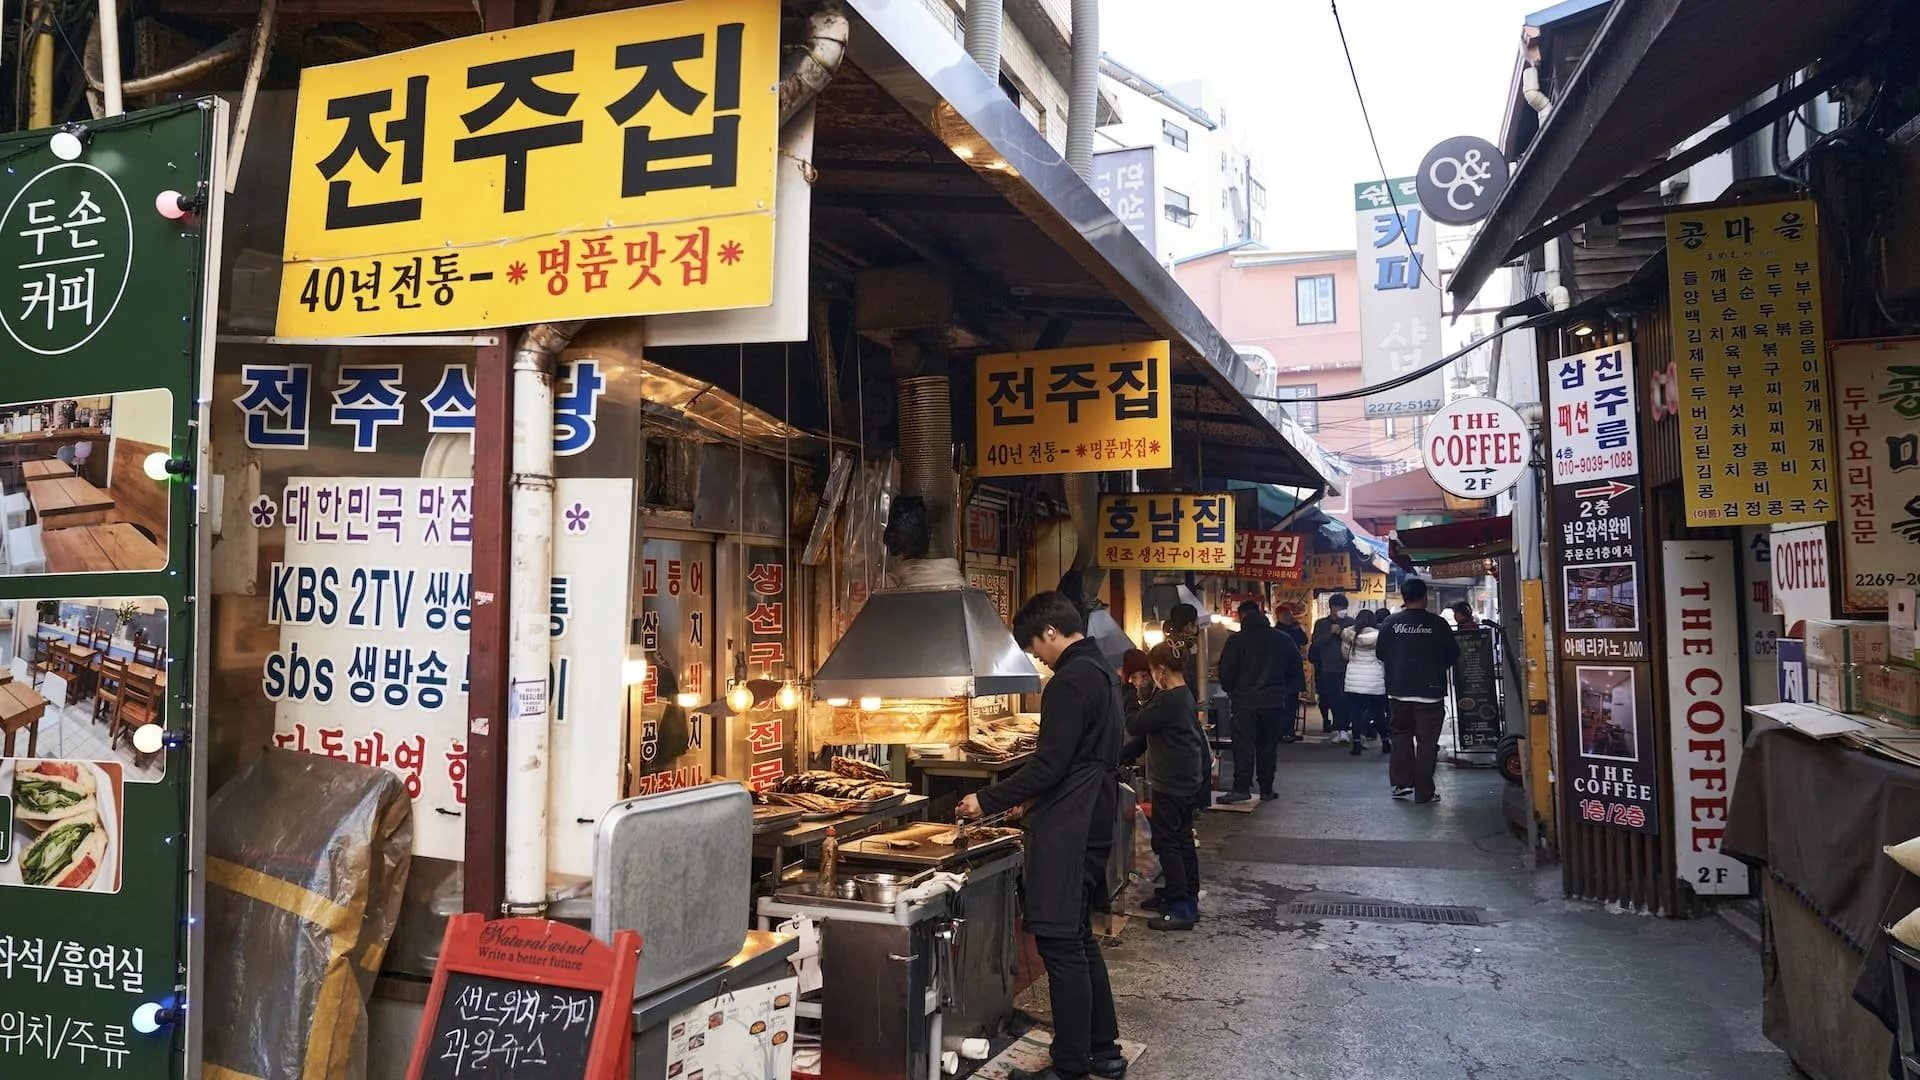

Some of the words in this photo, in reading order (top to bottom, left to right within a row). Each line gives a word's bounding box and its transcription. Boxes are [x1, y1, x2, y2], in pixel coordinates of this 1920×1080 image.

[316, 23, 745, 231] 전주집
[19, 190, 107, 255] 두손
[20, 268, 96, 331] 커피
[987, 358, 1159, 426] 전주집
[1368, 399, 1441, 414] 2272-5147
[1449, 413, 1501, 429] THE
[1558, 400, 1589, 437] 패션
[1431, 431, 1522, 467] COFFEE
[1556, 446, 1574, 460] 4층
[1558, 450, 1633, 477] 010-9039-1088
[1843, 387, 1878, 545] 두부요리전문
[285, 485, 403, 544] 대한민국
[419, 485, 473, 544] 맛집
[1104, 497, 1226, 543] 호남집
[1106, 546, 1134, 562] 원조
[1139, 546, 1226, 564] 생선구이전문
[1777, 539, 1826, 590] COFFEE
[643, 559, 703, 597] 고등어
[271, 566, 339, 625] KBS
[348, 568, 415, 628] 2TV
[1680, 581, 1713, 656] THE
[1564, 637, 1621, 658] 아메리카노
[265, 643, 334, 700] sbs
[348, 647, 448, 709] 생방송
[1588, 764, 1634, 783] THE
[1684, 668, 1729, 853] COFFEE
[1574, 778, 1651, 801] COFFEE
[1580, 799, 1646, 827] 1층/2층
[480, 922, 551, 950] Natural
[548, 939, 593, 955] wind
[479, 947, 506, 960] Write
[516, 951, 547, 966] better
[549, 957, 583, 970] future
